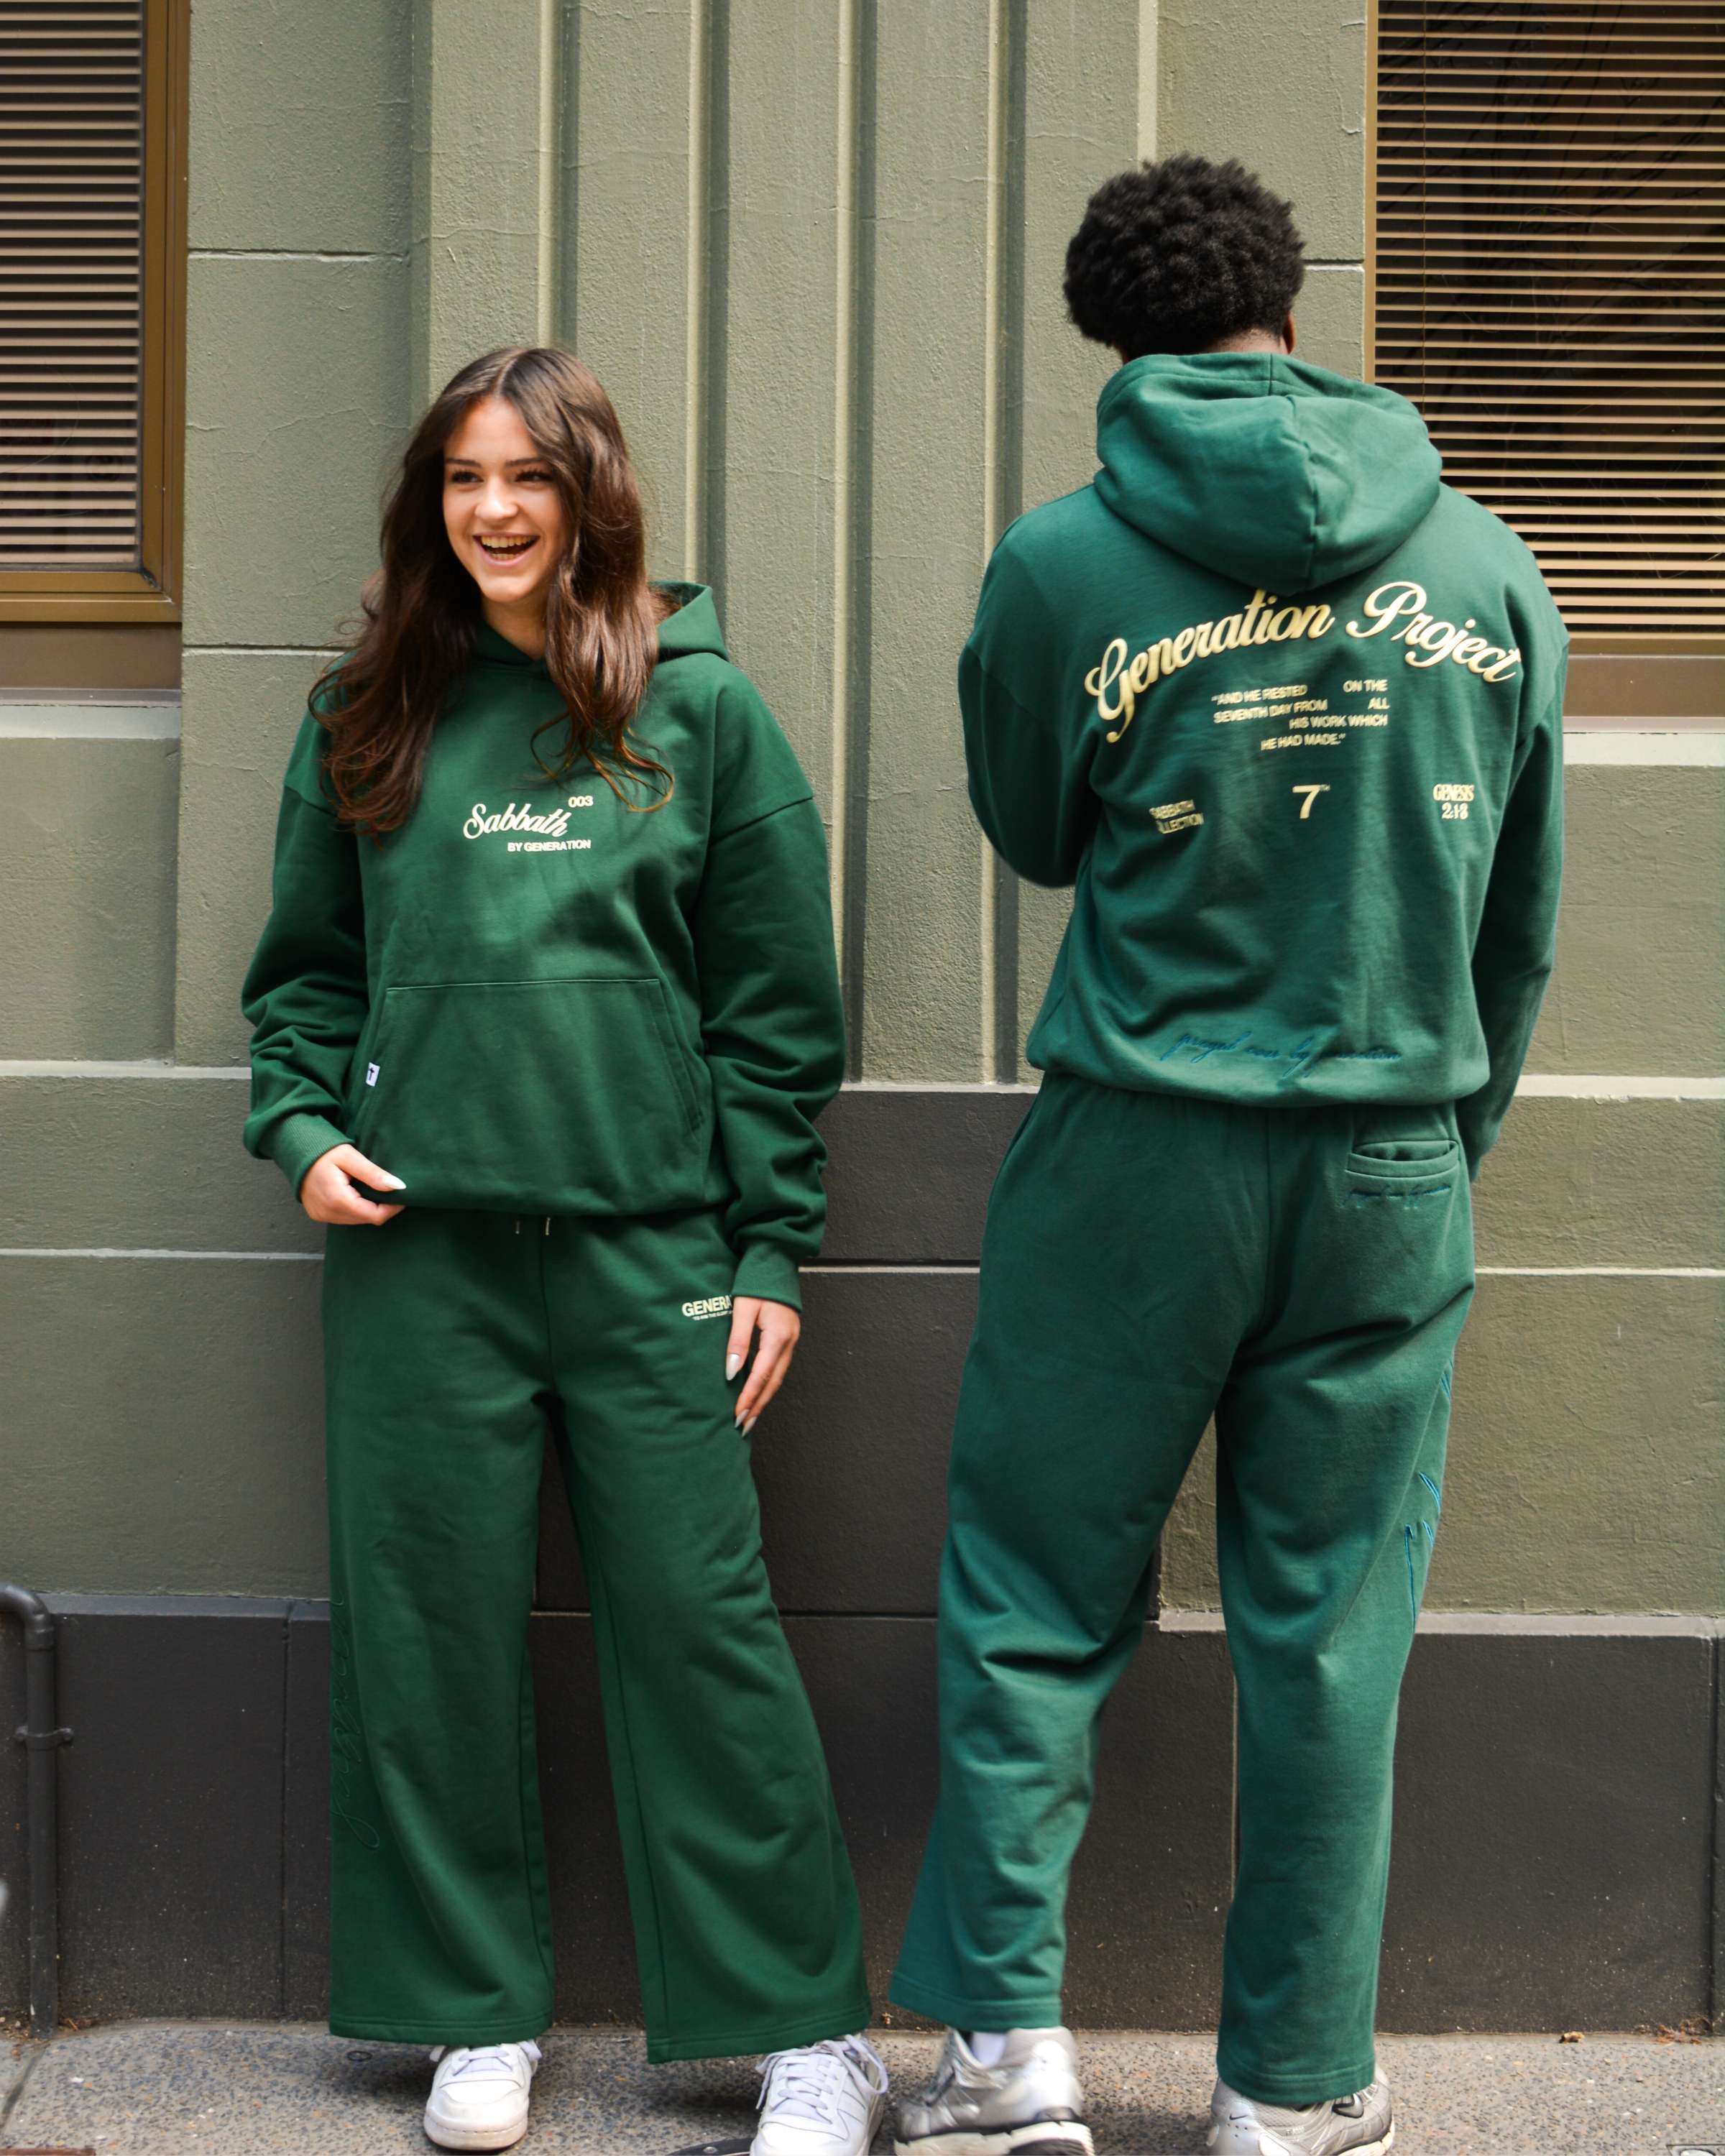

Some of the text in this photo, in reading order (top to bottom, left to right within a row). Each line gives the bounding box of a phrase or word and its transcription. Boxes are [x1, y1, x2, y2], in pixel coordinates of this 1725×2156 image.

[1085, 581, 1522, 743] Generation Project
[1243, 689, 1262, 702] HE
[1262, 684, 1308, 700] RESTED
[1343, 681, 1363, 693] ON
[1363, 679, 1388, 691] THE
[1213, 697, 1390, 724] SEVENTH DAY FROM ALL
[1289, 714, 1389, 729] HIS WORK WHICH
[1261, 737, 1278, 751] HE
[1278, 734, 1303, 748] HAD
[568, 795, 594, 808] 003
[463, 803, 572, 839] Sabbath
[507, 839, 592, 852] BY GENERATION
